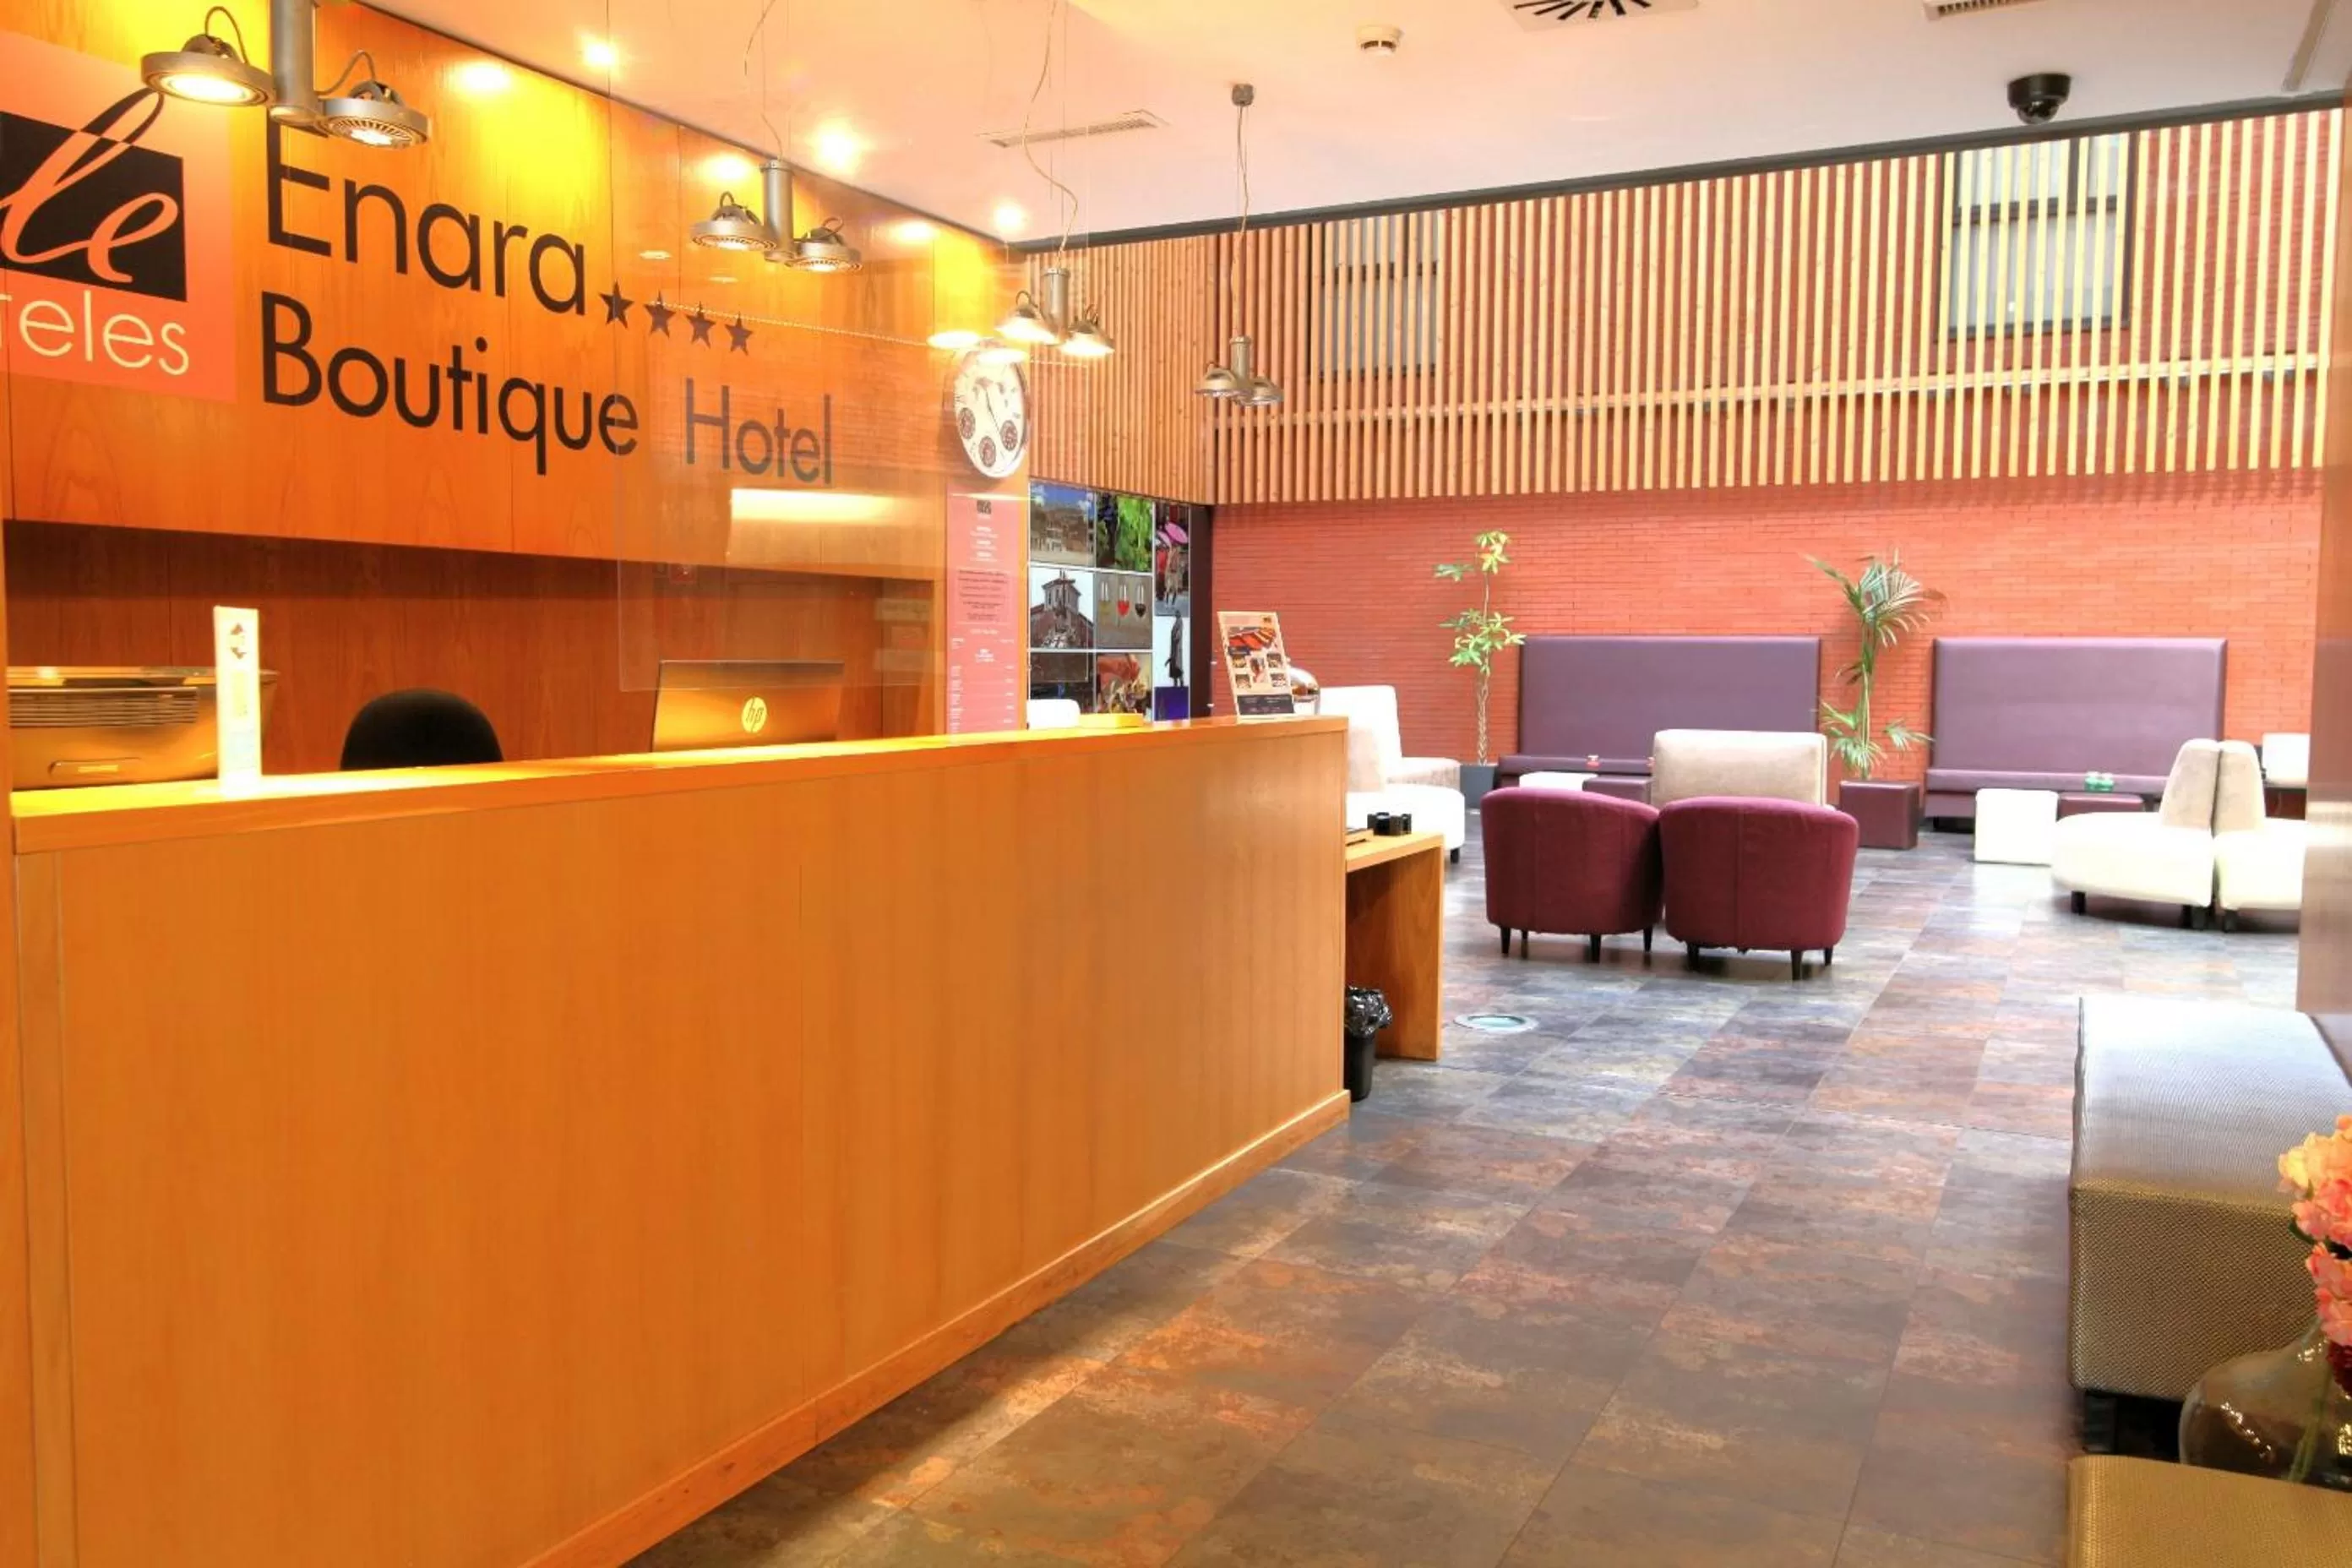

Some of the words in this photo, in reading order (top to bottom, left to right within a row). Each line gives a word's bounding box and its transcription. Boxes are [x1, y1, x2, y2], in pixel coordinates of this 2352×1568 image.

[266, 108, 585, 316] Enara
[0, 290, 189, 375] eles
[262, 291, 639, 476] Boutique
[686, 378, 831, 484] Hotel
[744, 697, 765, 732] hp
